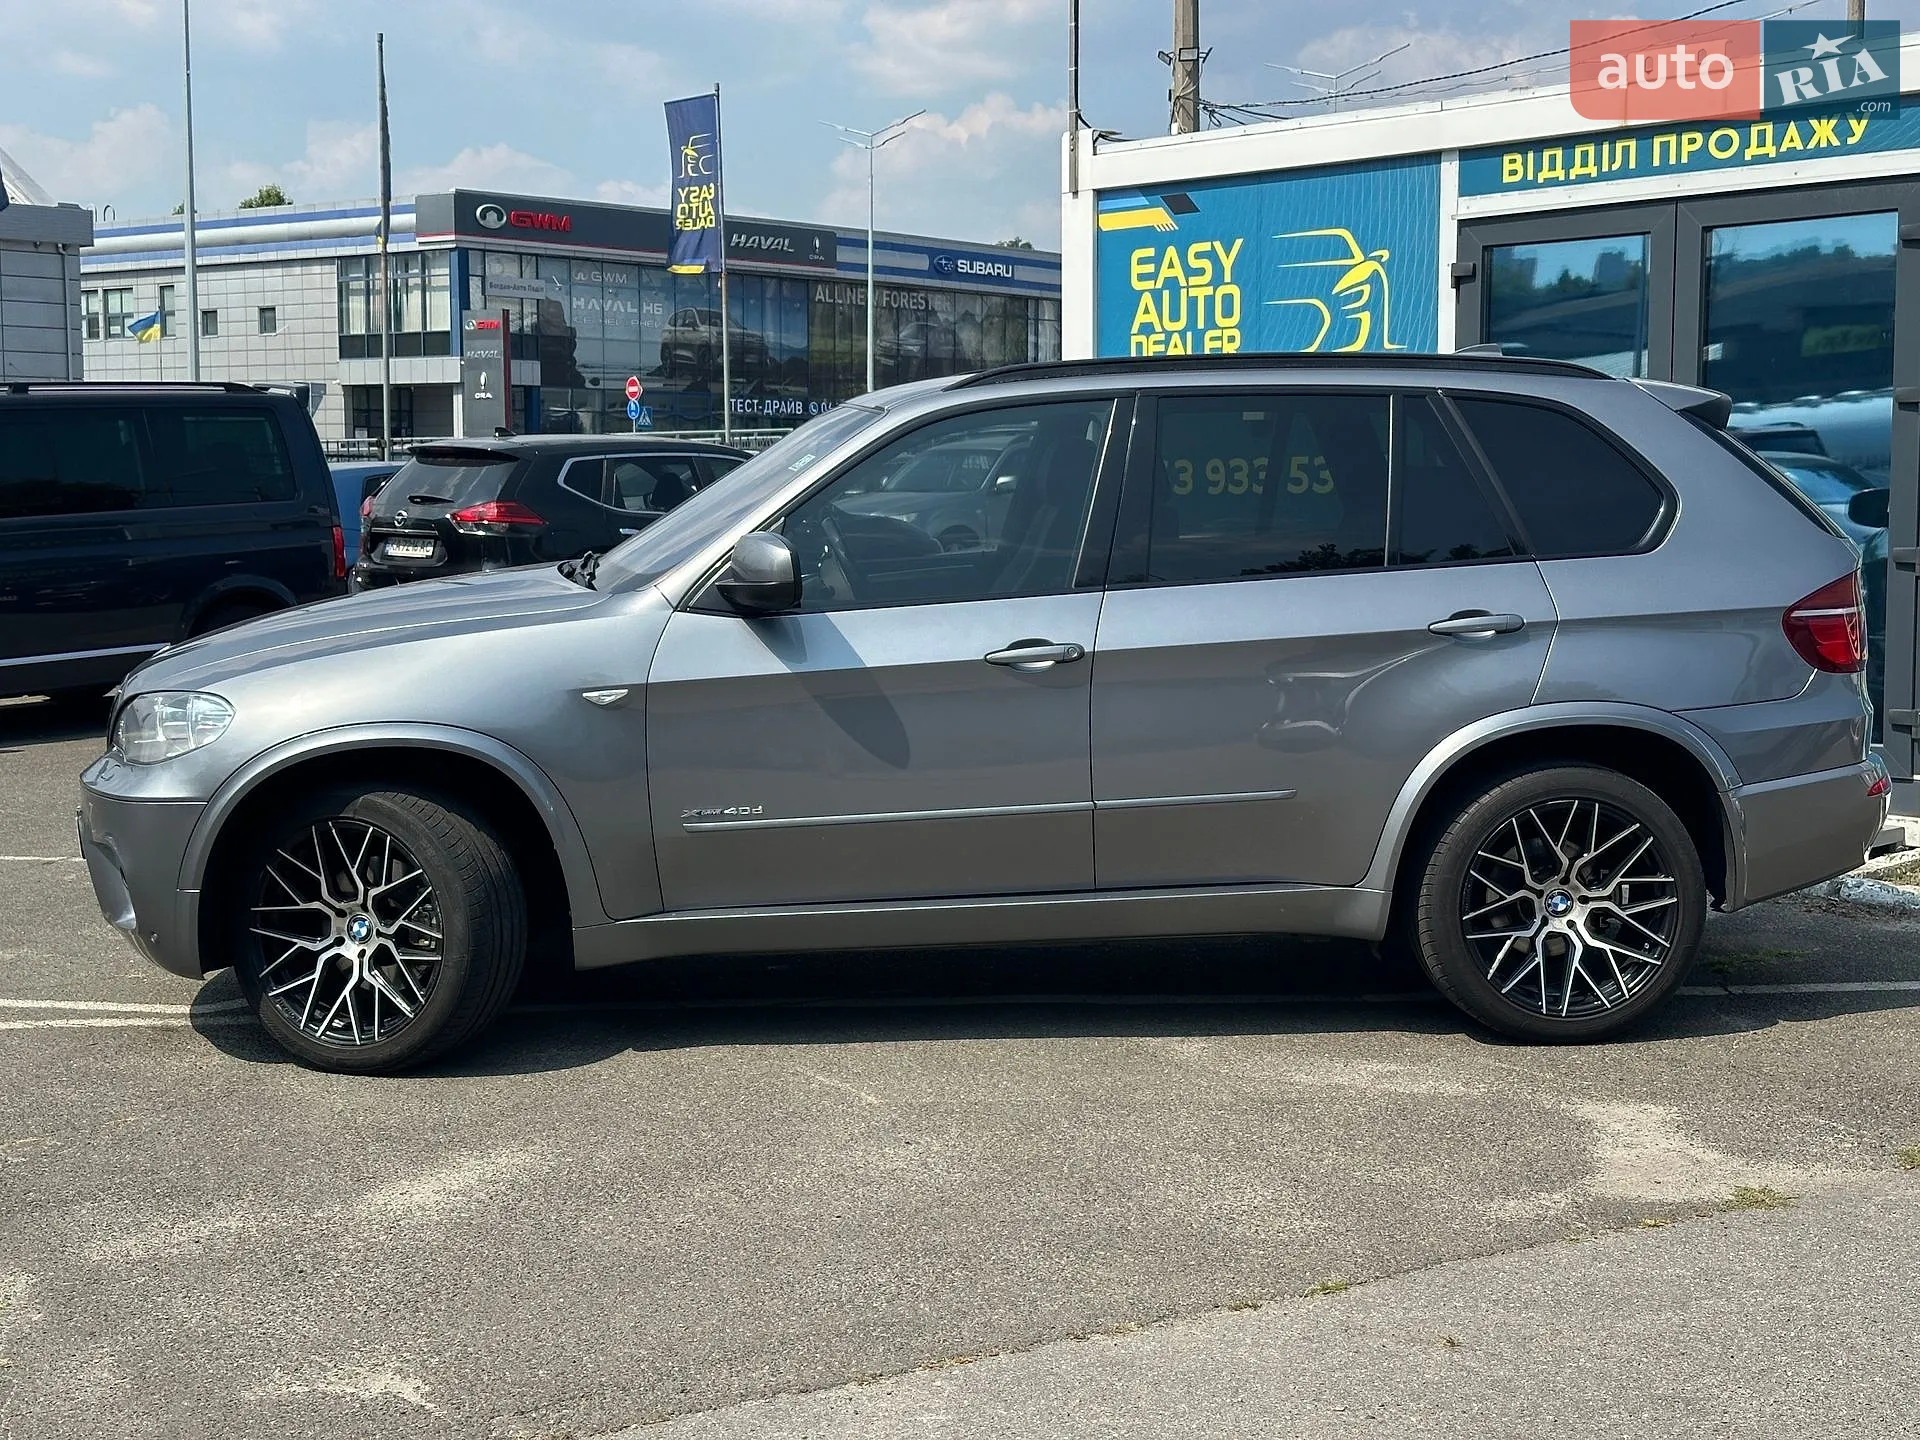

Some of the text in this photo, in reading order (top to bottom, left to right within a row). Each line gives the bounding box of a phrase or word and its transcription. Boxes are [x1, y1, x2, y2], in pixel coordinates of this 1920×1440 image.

[1502, 112, 1871, 183] ВІДДІЛ ПРОДАЖУ
[510, 210, 572, 232] GWM
[730, 233, 795, 252] HAVAL
[957, 259, 1013, 278] SUBARU
[1131, 238, 1244, 290] EASY
[591, 271, 627, 284] GWM
[814, 283, 843, 303] ALL
[572, 296, 663, 314] HAVAL H6
[1130, 284, 1241, 334] AUTO
[1131, 328, 1241, 357] DEALER
[730, 398, 803, 416] ТЕСТ-ДРАЙВ
